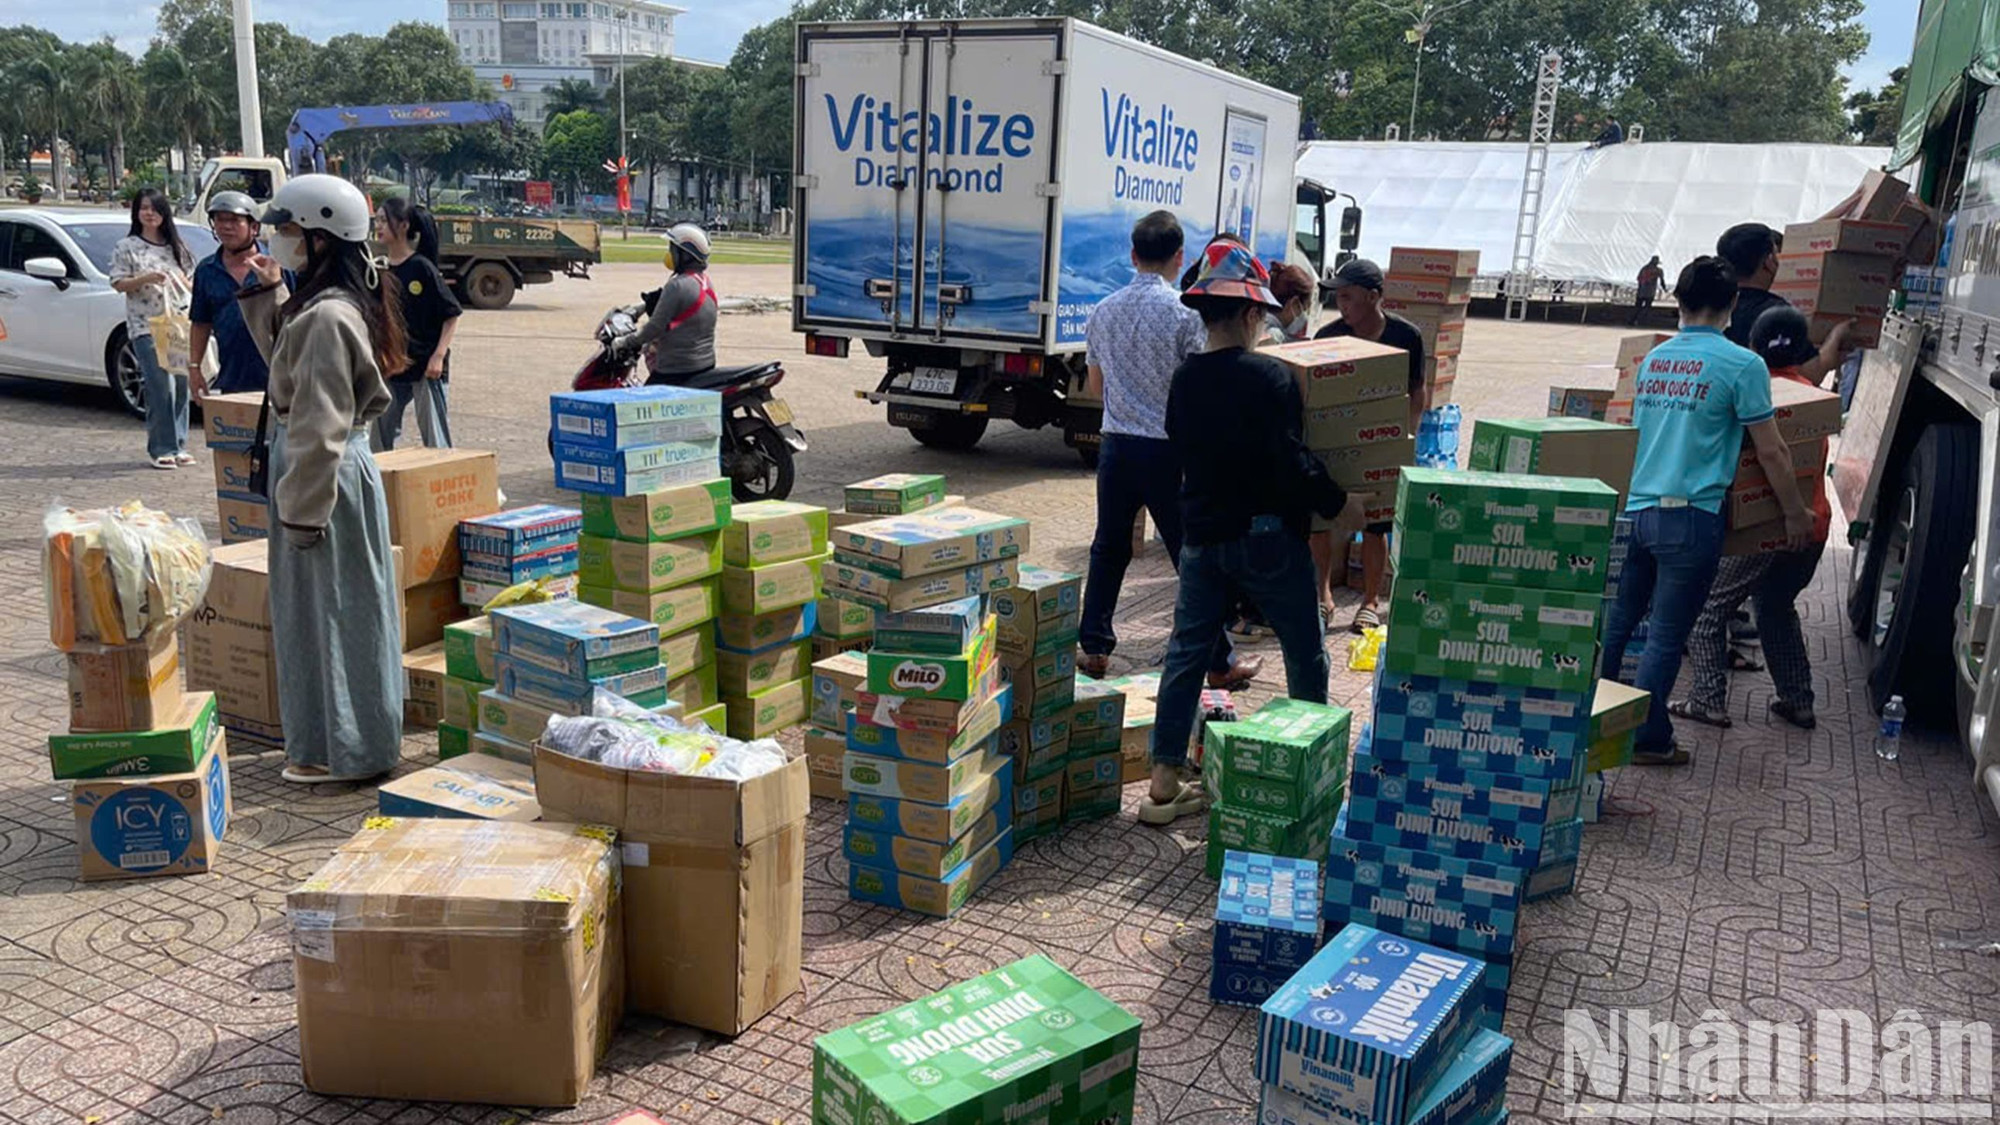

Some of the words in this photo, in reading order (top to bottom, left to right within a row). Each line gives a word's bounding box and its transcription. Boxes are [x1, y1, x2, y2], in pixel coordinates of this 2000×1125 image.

[824, 93, 1035, 158] Vitalize
[1101, 87, 1199, 172] Vitalize
[854, 157, 1003, 193] Diamond
[1114, 165, 1184, 206] Diamond
[1057, 303, 1075, 318] GIAO
[924, 368, 945, 379] 47C
[1671, 360, 1704, 378] KHOA
[1484, 501, 1539, 521] Vinamilk
[1453, 543, 1495, 567] DINH
[1469, 599, 1524, 619] Vinamilk
[1438, 639, 1480, 662] DINH
[898, 668, 940, 684] MILO
[114, 803, 166, 830] ICY
[974, 990, 1045, 1031] DINH
[1350, 952, 1468, 1044] Vinamilk
[1301, 1057, 1355, 1092] Vinamilk
